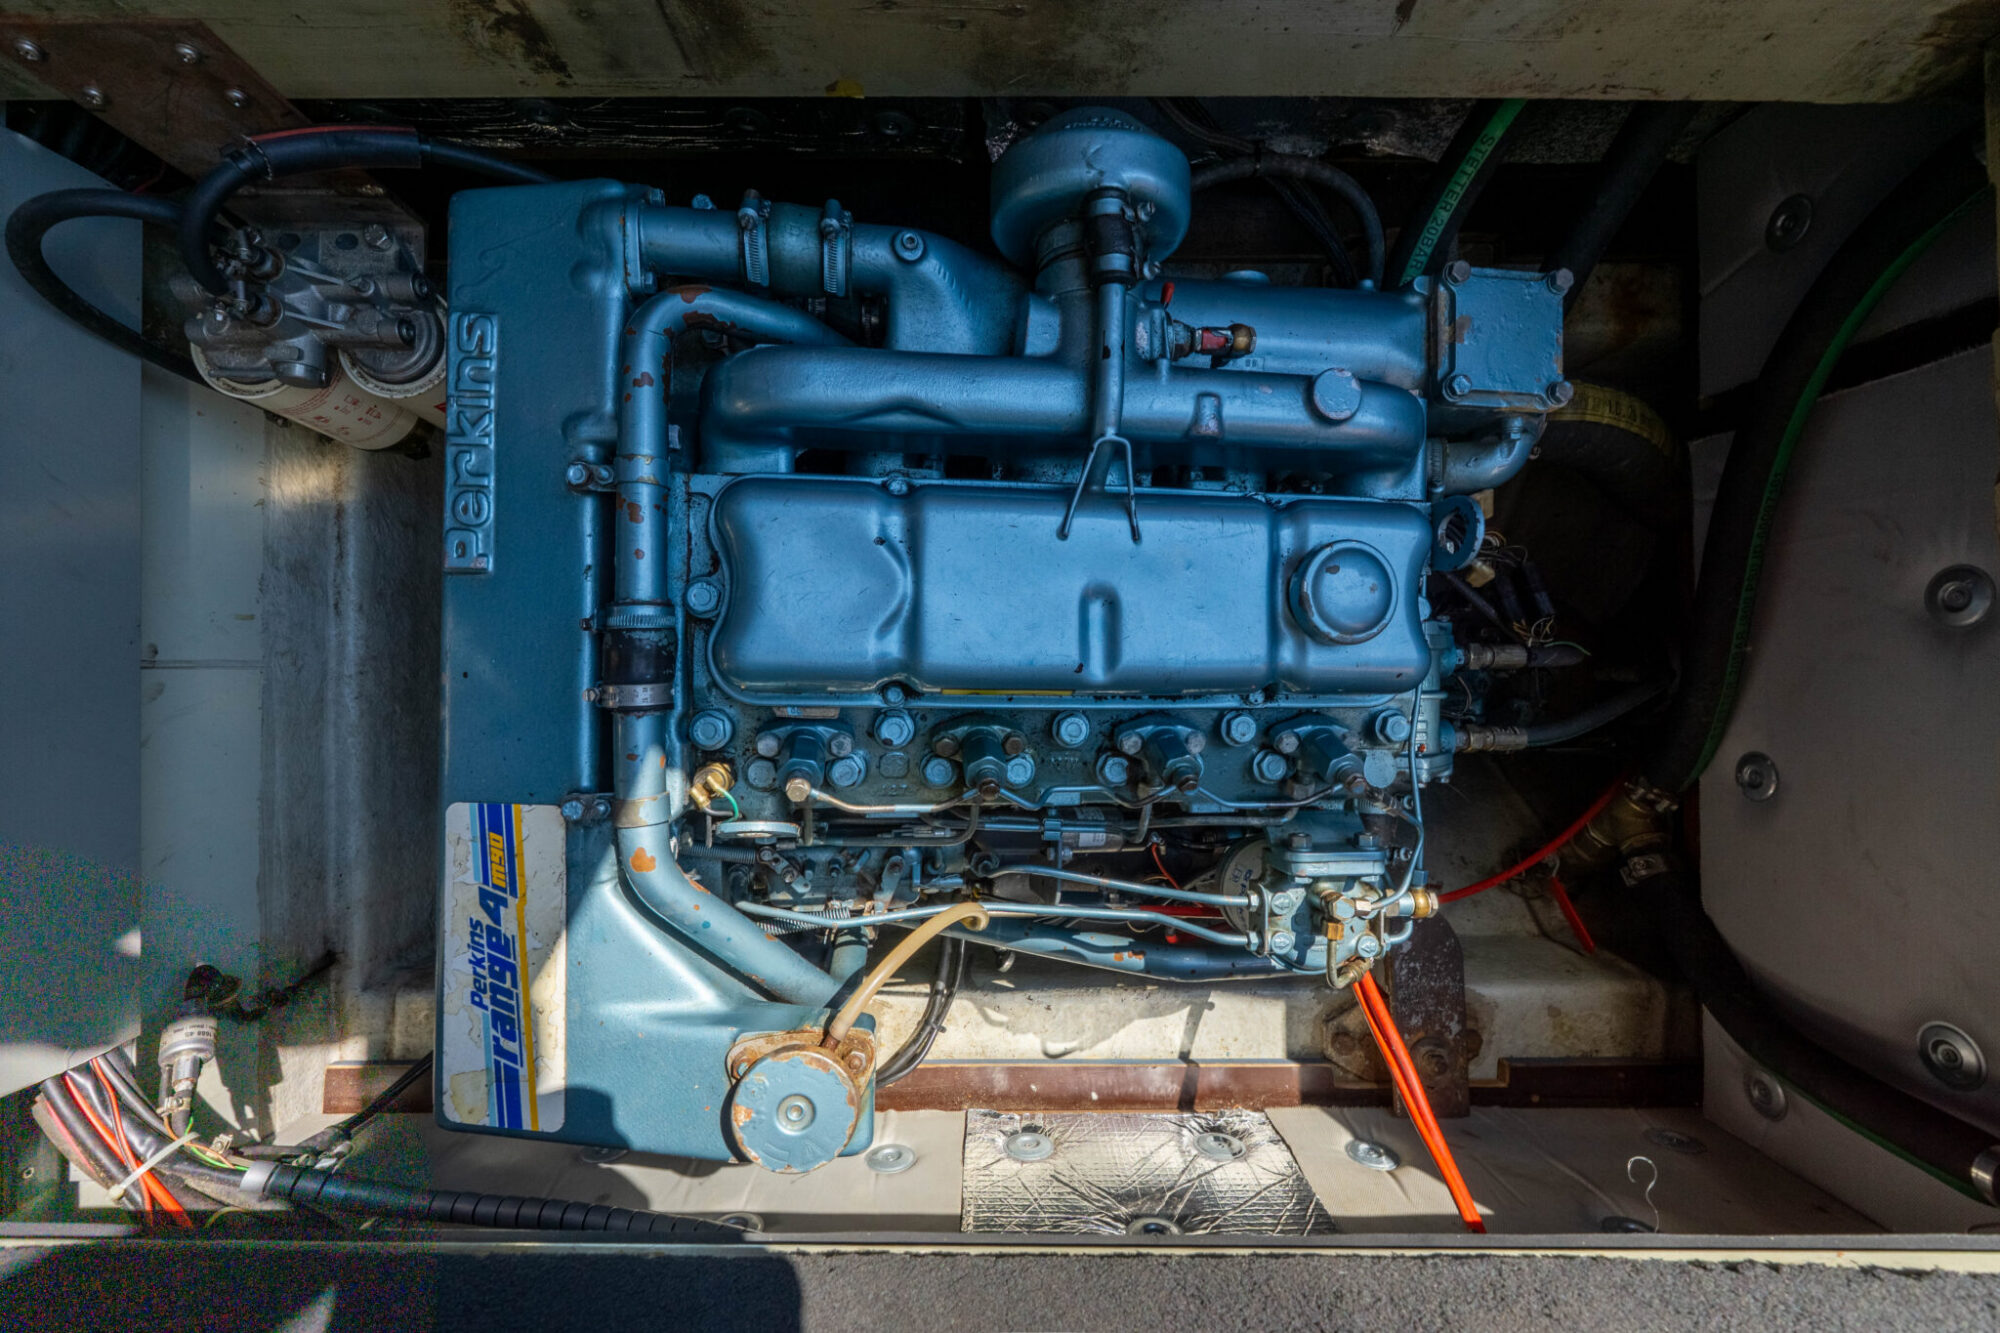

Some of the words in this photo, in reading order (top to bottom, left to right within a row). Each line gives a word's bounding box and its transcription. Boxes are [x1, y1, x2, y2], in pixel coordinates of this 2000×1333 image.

[1410, 215, 1444, 270] 20BAR
[444, 314, 496, 569] Perkins
[467, 916, 489, 1012] Perkins
